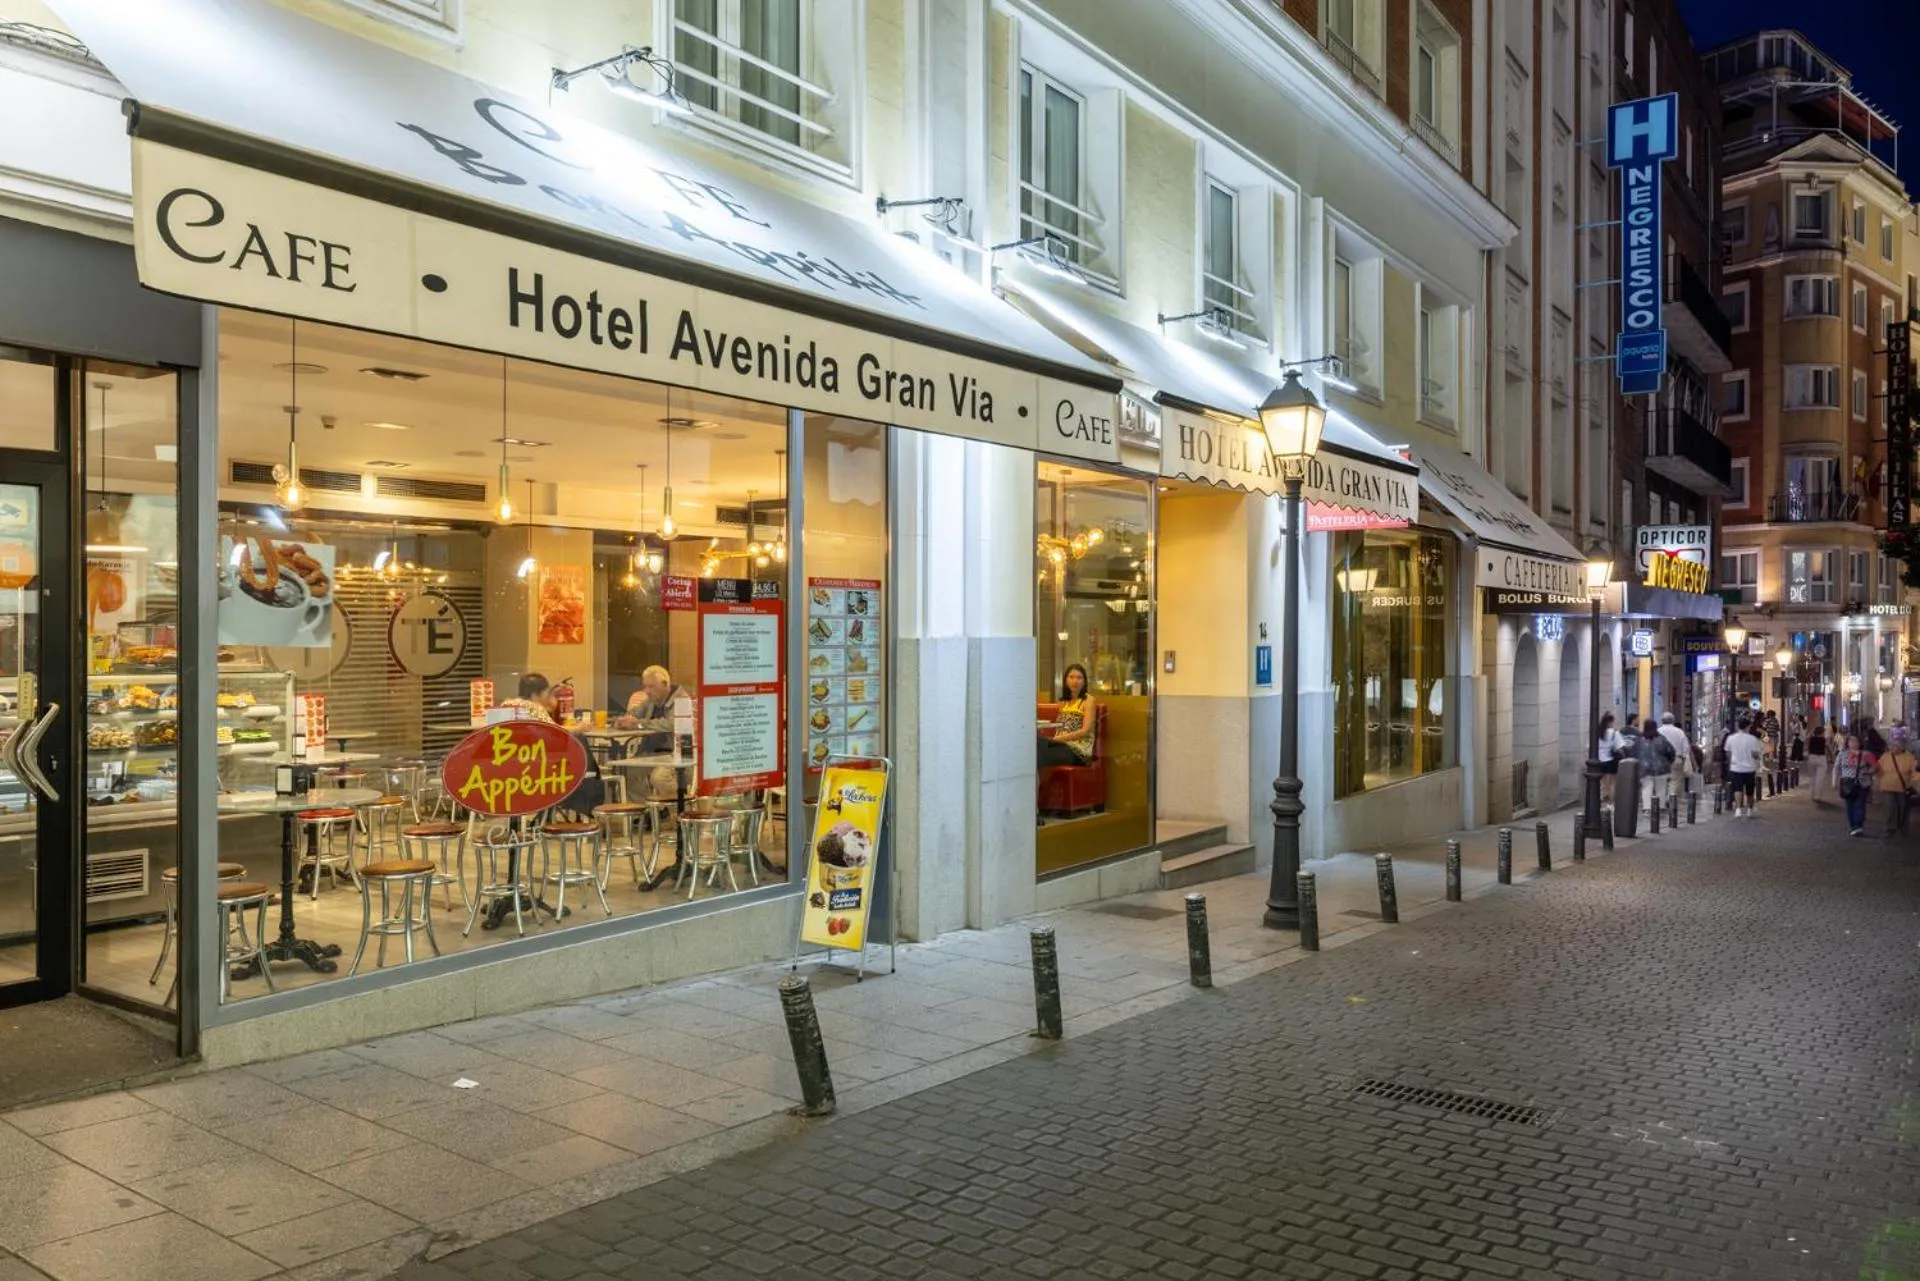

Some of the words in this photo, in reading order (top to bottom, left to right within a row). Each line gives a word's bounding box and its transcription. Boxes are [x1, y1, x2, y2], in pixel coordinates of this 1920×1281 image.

[1614, 98, 1668, 161] H
[474, 98, 771, 230] CFE
[156, 187, 357, 293] CAFE
[1627, 165, 1655, 329] NEGRESCO
[508, 267, 648, 355] Hotel
[669, 309, 841, 394] Avenida
[857, 352, 936, 412] Gran
[949, 373, 995, 423] Via
[1056, 399, 1113, 446] CAFE
[1179, 424, 1252, 474] HOTEL
[1340, 466, 1382, 504] GRAN
[1386, 478, 1410, 510] VIA
[1640, 530, 1706, 545] OPTICOR
[1504, 555, 1571, 593] CAFETERIA
[1650, 552, 1707, 595] NEGRESCO
[1498, 593, 1542, 604] BOLUS
[1547, 593, 1606, 604] BURG
[1869, 605, 1898, 615] HOTEL
[401, 605, 454, 654] TÉ
[489, 726, 547, 768] Bon
[458, 757, 574, 814] Appétit
